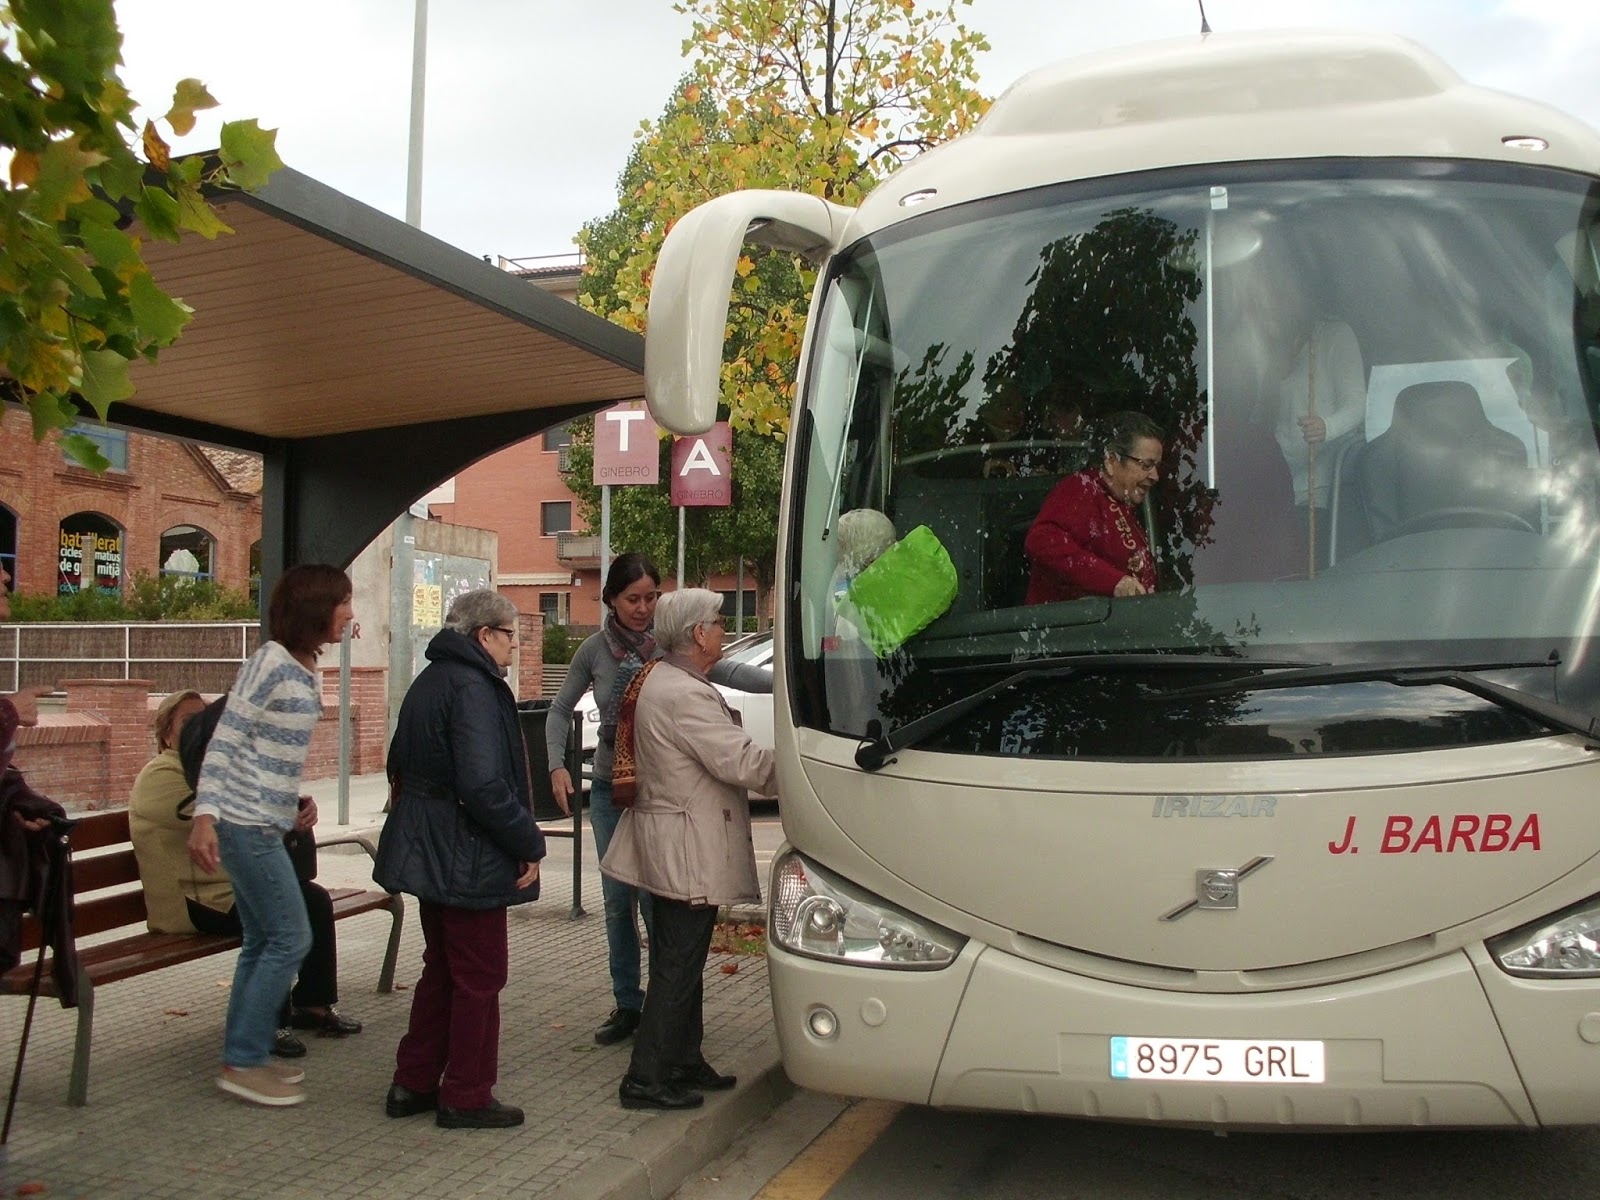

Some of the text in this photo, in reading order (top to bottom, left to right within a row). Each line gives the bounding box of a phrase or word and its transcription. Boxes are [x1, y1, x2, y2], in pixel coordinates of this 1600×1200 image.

[606, 410, 645, 452] T
[679, 438, 721, 476] A
[600, 465, 650, 478] GINEBRÓ
[61, 529, 120, 551] batlerat
[60, 546, 120, 562] cicles matius
[60, 558, 72, 572] de
[97, 562, 120, 578] mitjà
[1152, 795, 1278, 818] IRIZAR
[1328, 813, 1542, 854] J. BARBA
[1137, 1043, 1310, 1077] 8975 GRL
